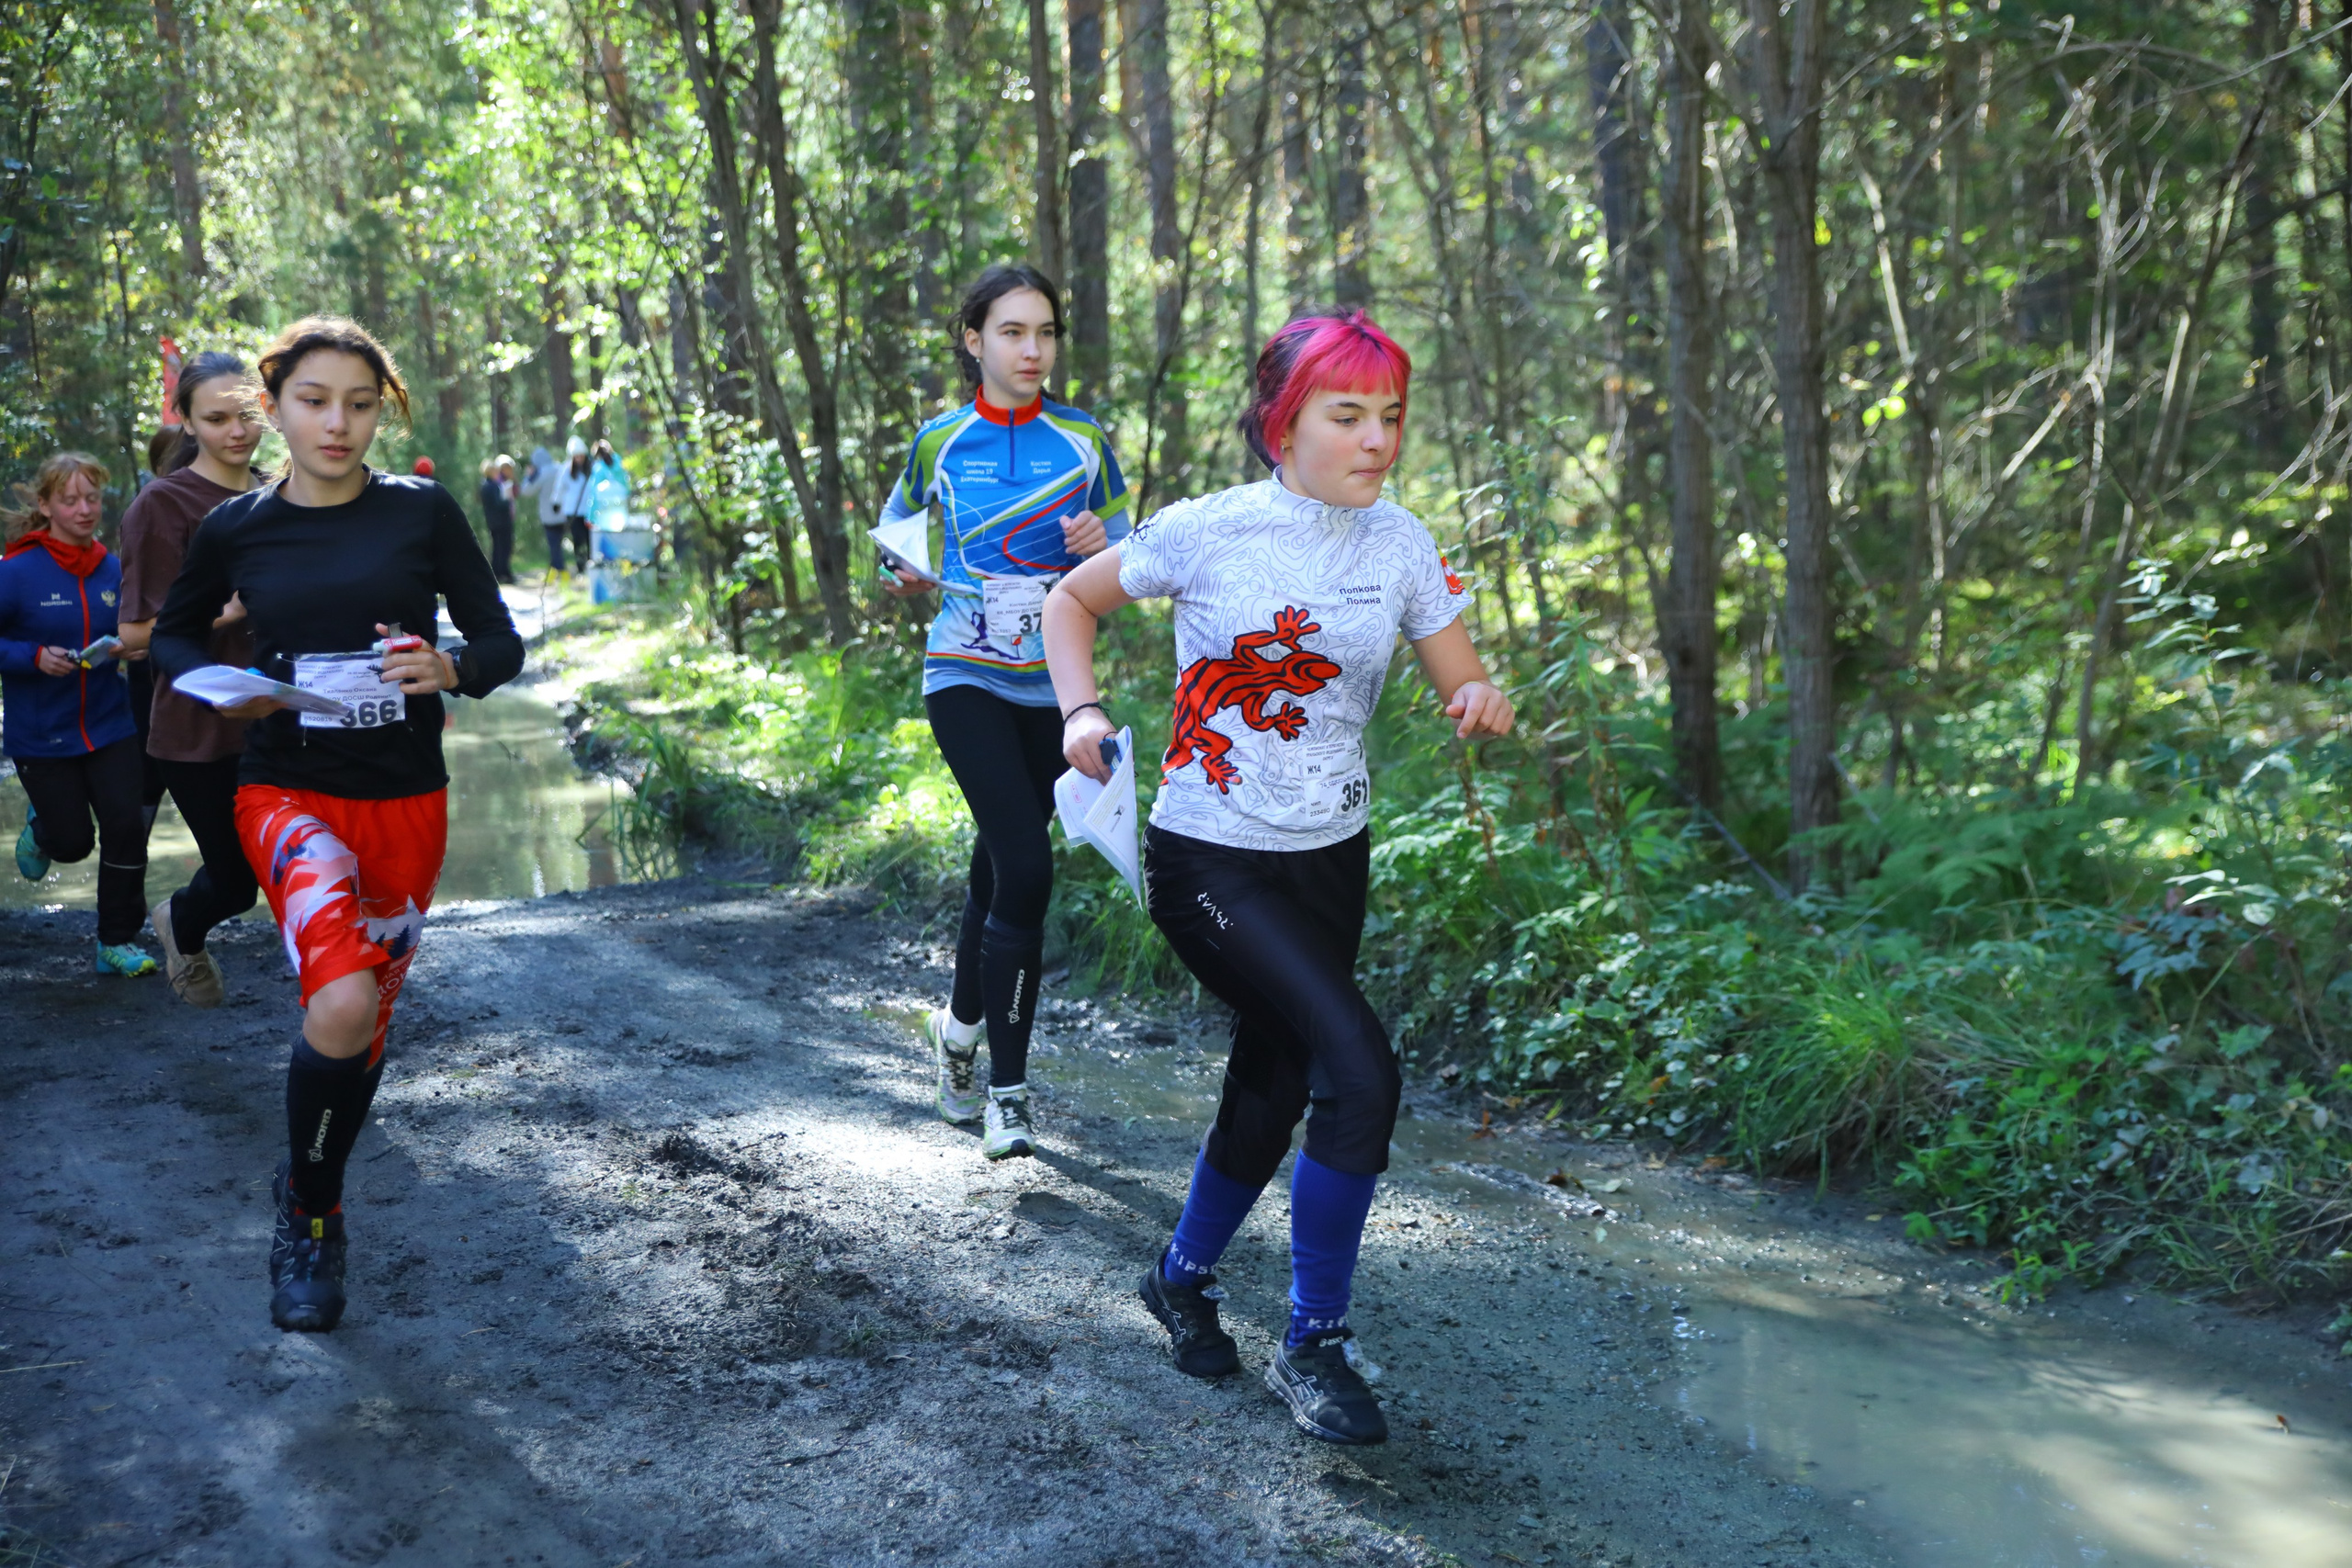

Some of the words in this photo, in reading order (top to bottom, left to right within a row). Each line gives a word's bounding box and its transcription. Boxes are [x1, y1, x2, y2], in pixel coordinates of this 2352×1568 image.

[1339, 584, 1382, 595] Попкова
[1346, 597, 1381, 605] Полина
[339, 699, 397, 728] 366
[1306, 764, 1321, 774] Ж14
[1341, 777, 1368, 812] 361
[1012, 968, 1025, 1010] NORD
[314, 1109, 332, 1148] NORD
